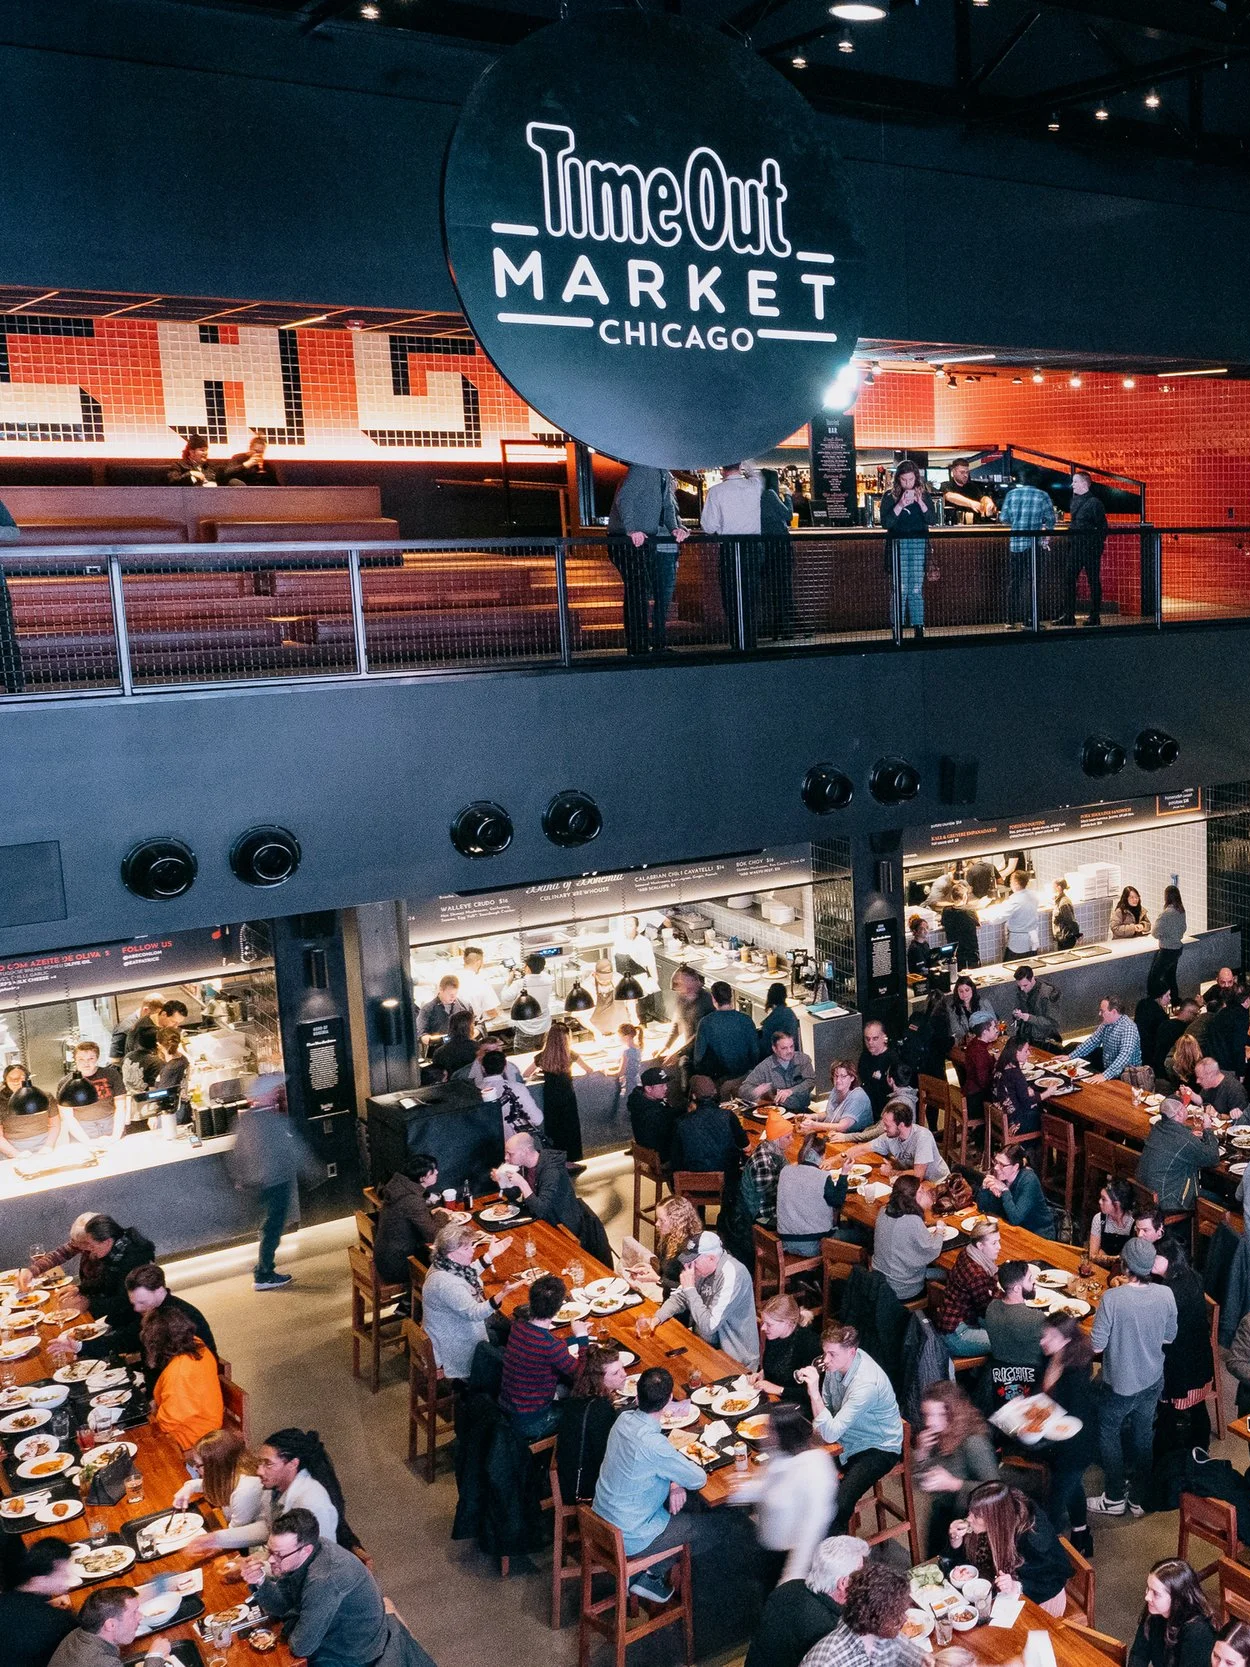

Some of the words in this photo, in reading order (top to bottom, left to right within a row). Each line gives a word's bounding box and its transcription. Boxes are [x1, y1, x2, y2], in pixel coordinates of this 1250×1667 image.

[493, 247, 836, 321] MARKET
[599, 319, 754, 352] CHICAGO
[634, 872, 667, 883] CALABRIAN
[684, 866, 714, 876] CAVATELLI
[539, 892, 571, 902] CULINARY
[572, 886, 610, 897] BREWHOUSE
[440, 903, 472, 912] WALLEYE
[473, 899, 495, 908] CRUDO
[121, 941, 159, 954] FOLLOW
[160, 940, 173, 948] US
[75, 951, 101, 961] OLIVA
[992, 1366, 1036, 1383] RICHIE
